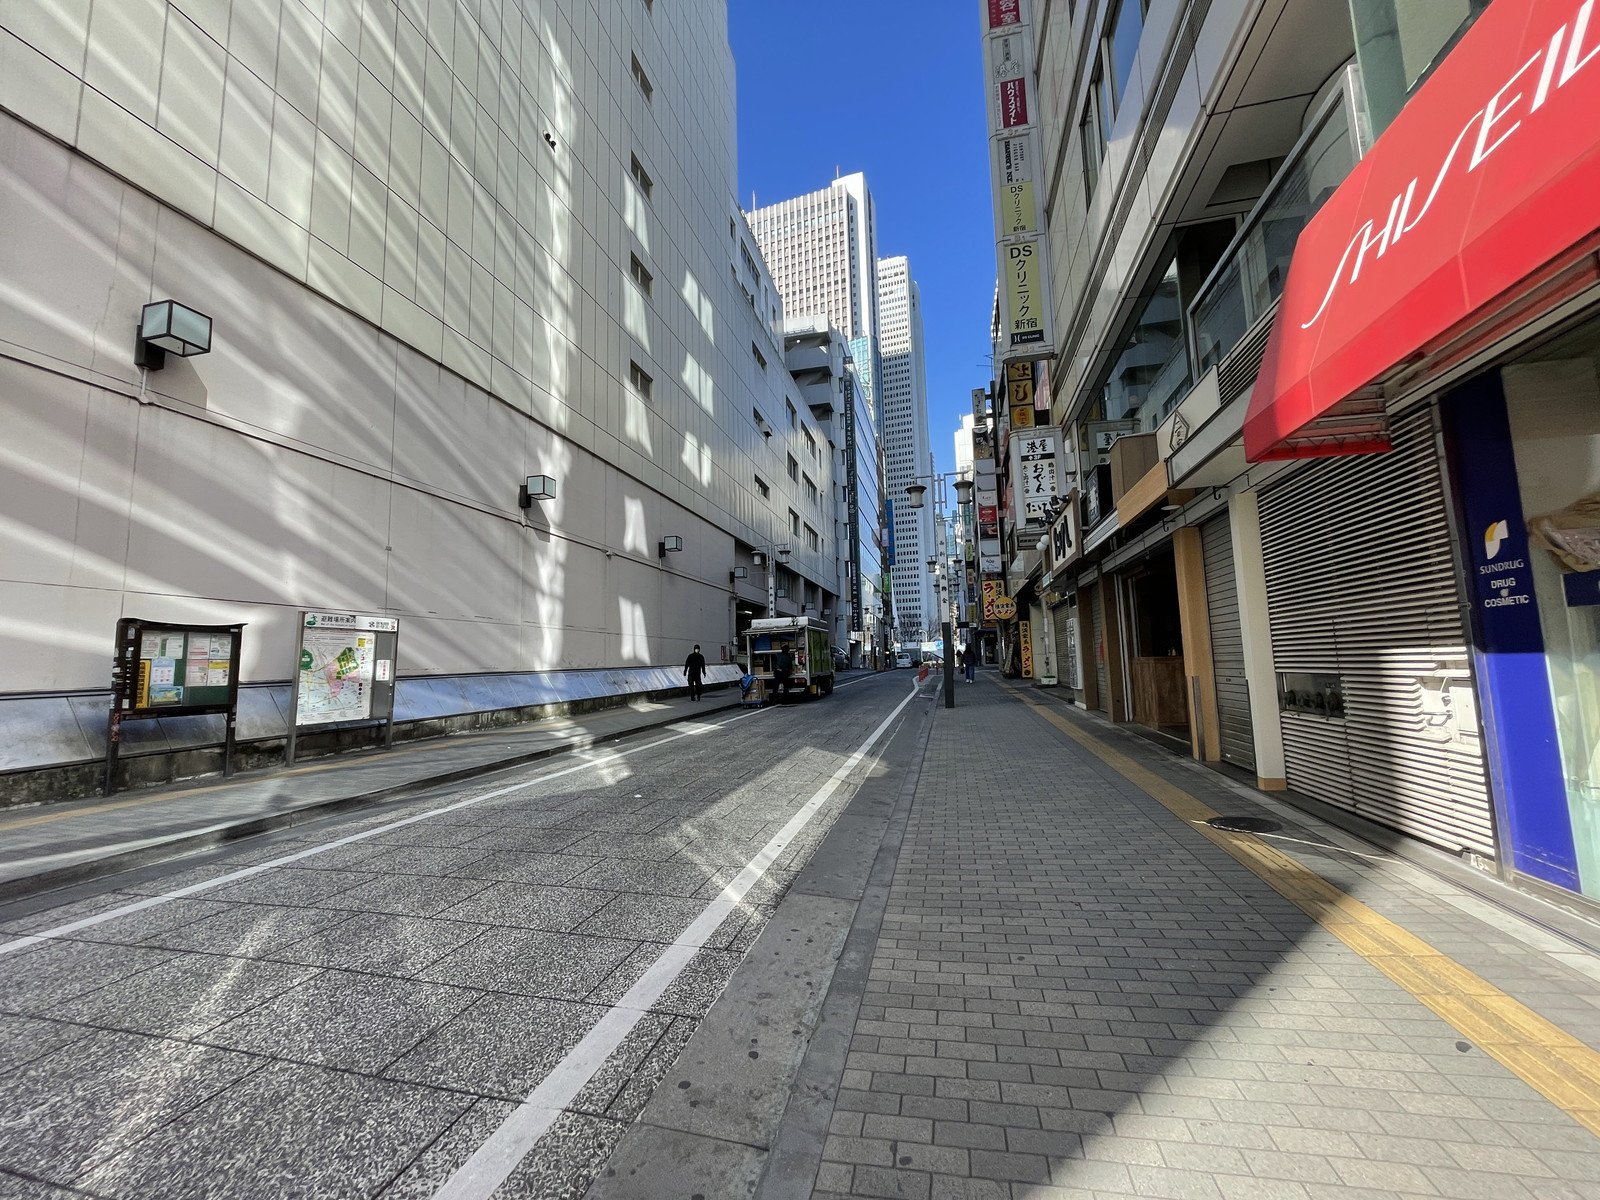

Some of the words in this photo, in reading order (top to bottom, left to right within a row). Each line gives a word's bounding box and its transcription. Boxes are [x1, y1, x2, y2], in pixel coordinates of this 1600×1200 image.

[1007, 82, 1017, 125] ハウスメイト
[1010, 185, 1024, 194] DS
[1014, 193, 1022, 225] クリニック
[1010, 245, 1033, 259] DS
[1015, 259, 1030, 317] クリニック
[1014, 317, 1038, 330] 新宿
[1027, 439, 1047, 453] 港屋
[1033, 463, 1046, 493] おでん
[1480, 559, 1524, 574] SUNDRUG
[995, 582, 1003, 598] 横浜
[1491, 577, 1516, 589] DRUG
[1484, 594, 1529, 608] COSMETIC
